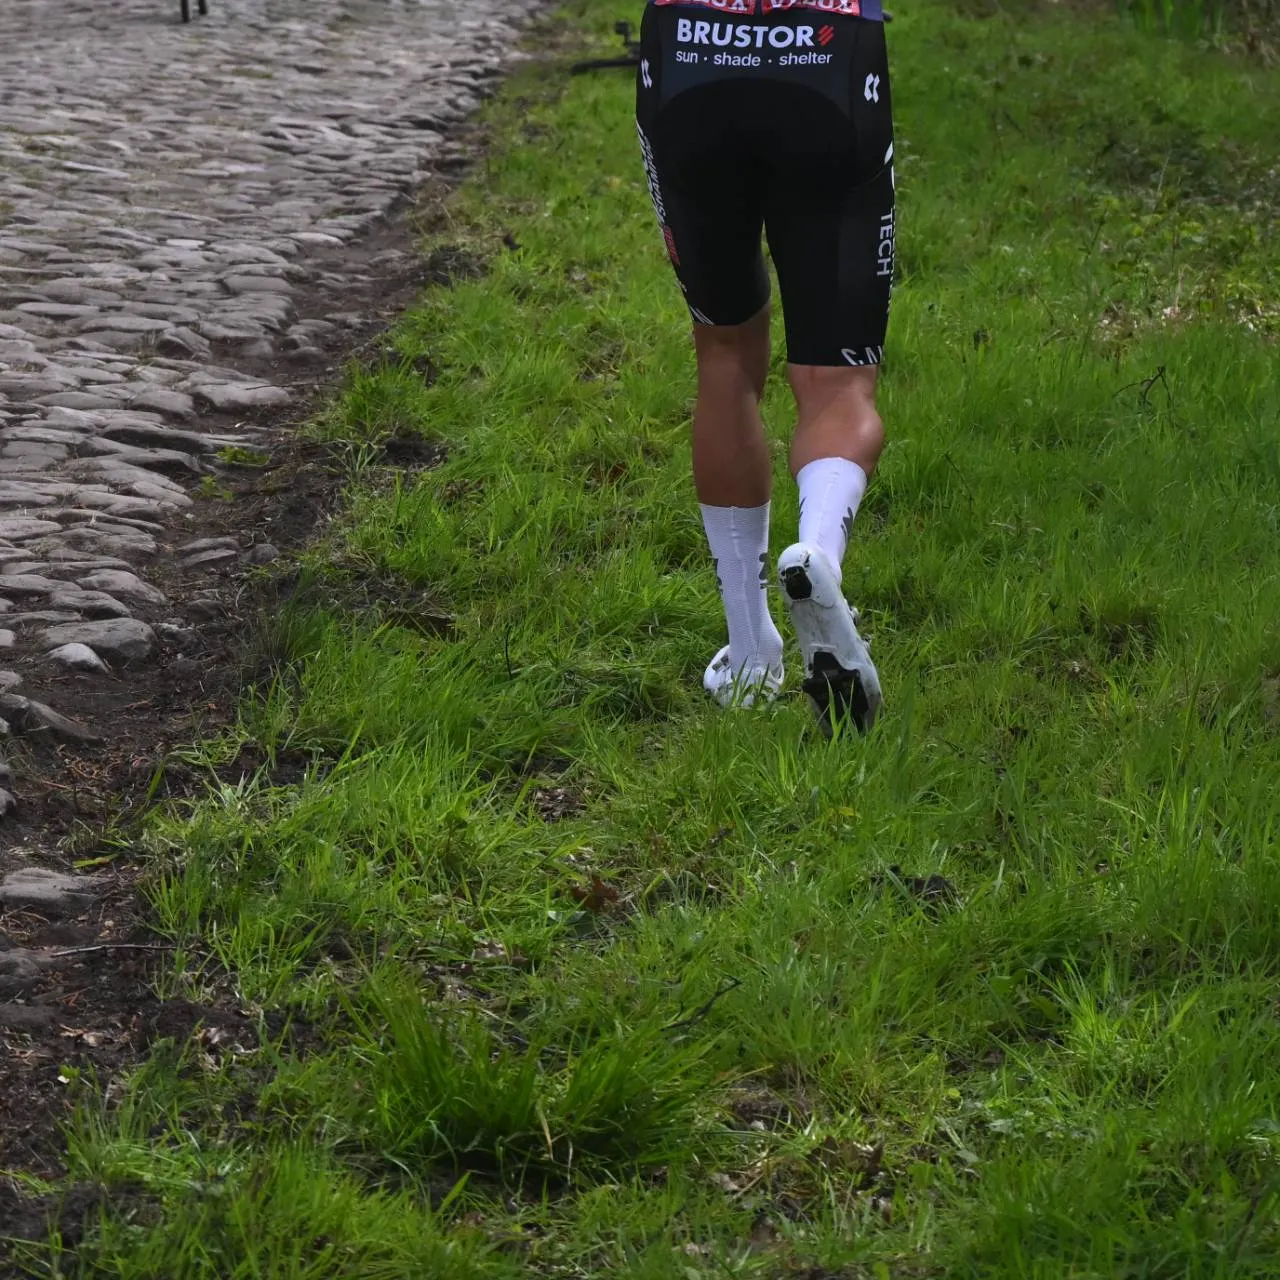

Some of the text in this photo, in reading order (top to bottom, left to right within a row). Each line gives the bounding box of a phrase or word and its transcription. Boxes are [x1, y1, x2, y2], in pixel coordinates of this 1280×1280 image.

[676, 18, 815, 48] BRUSTOR
[676, 50, 832, 66] sun shade shelter
[876, 207, 893, 276] TECH
